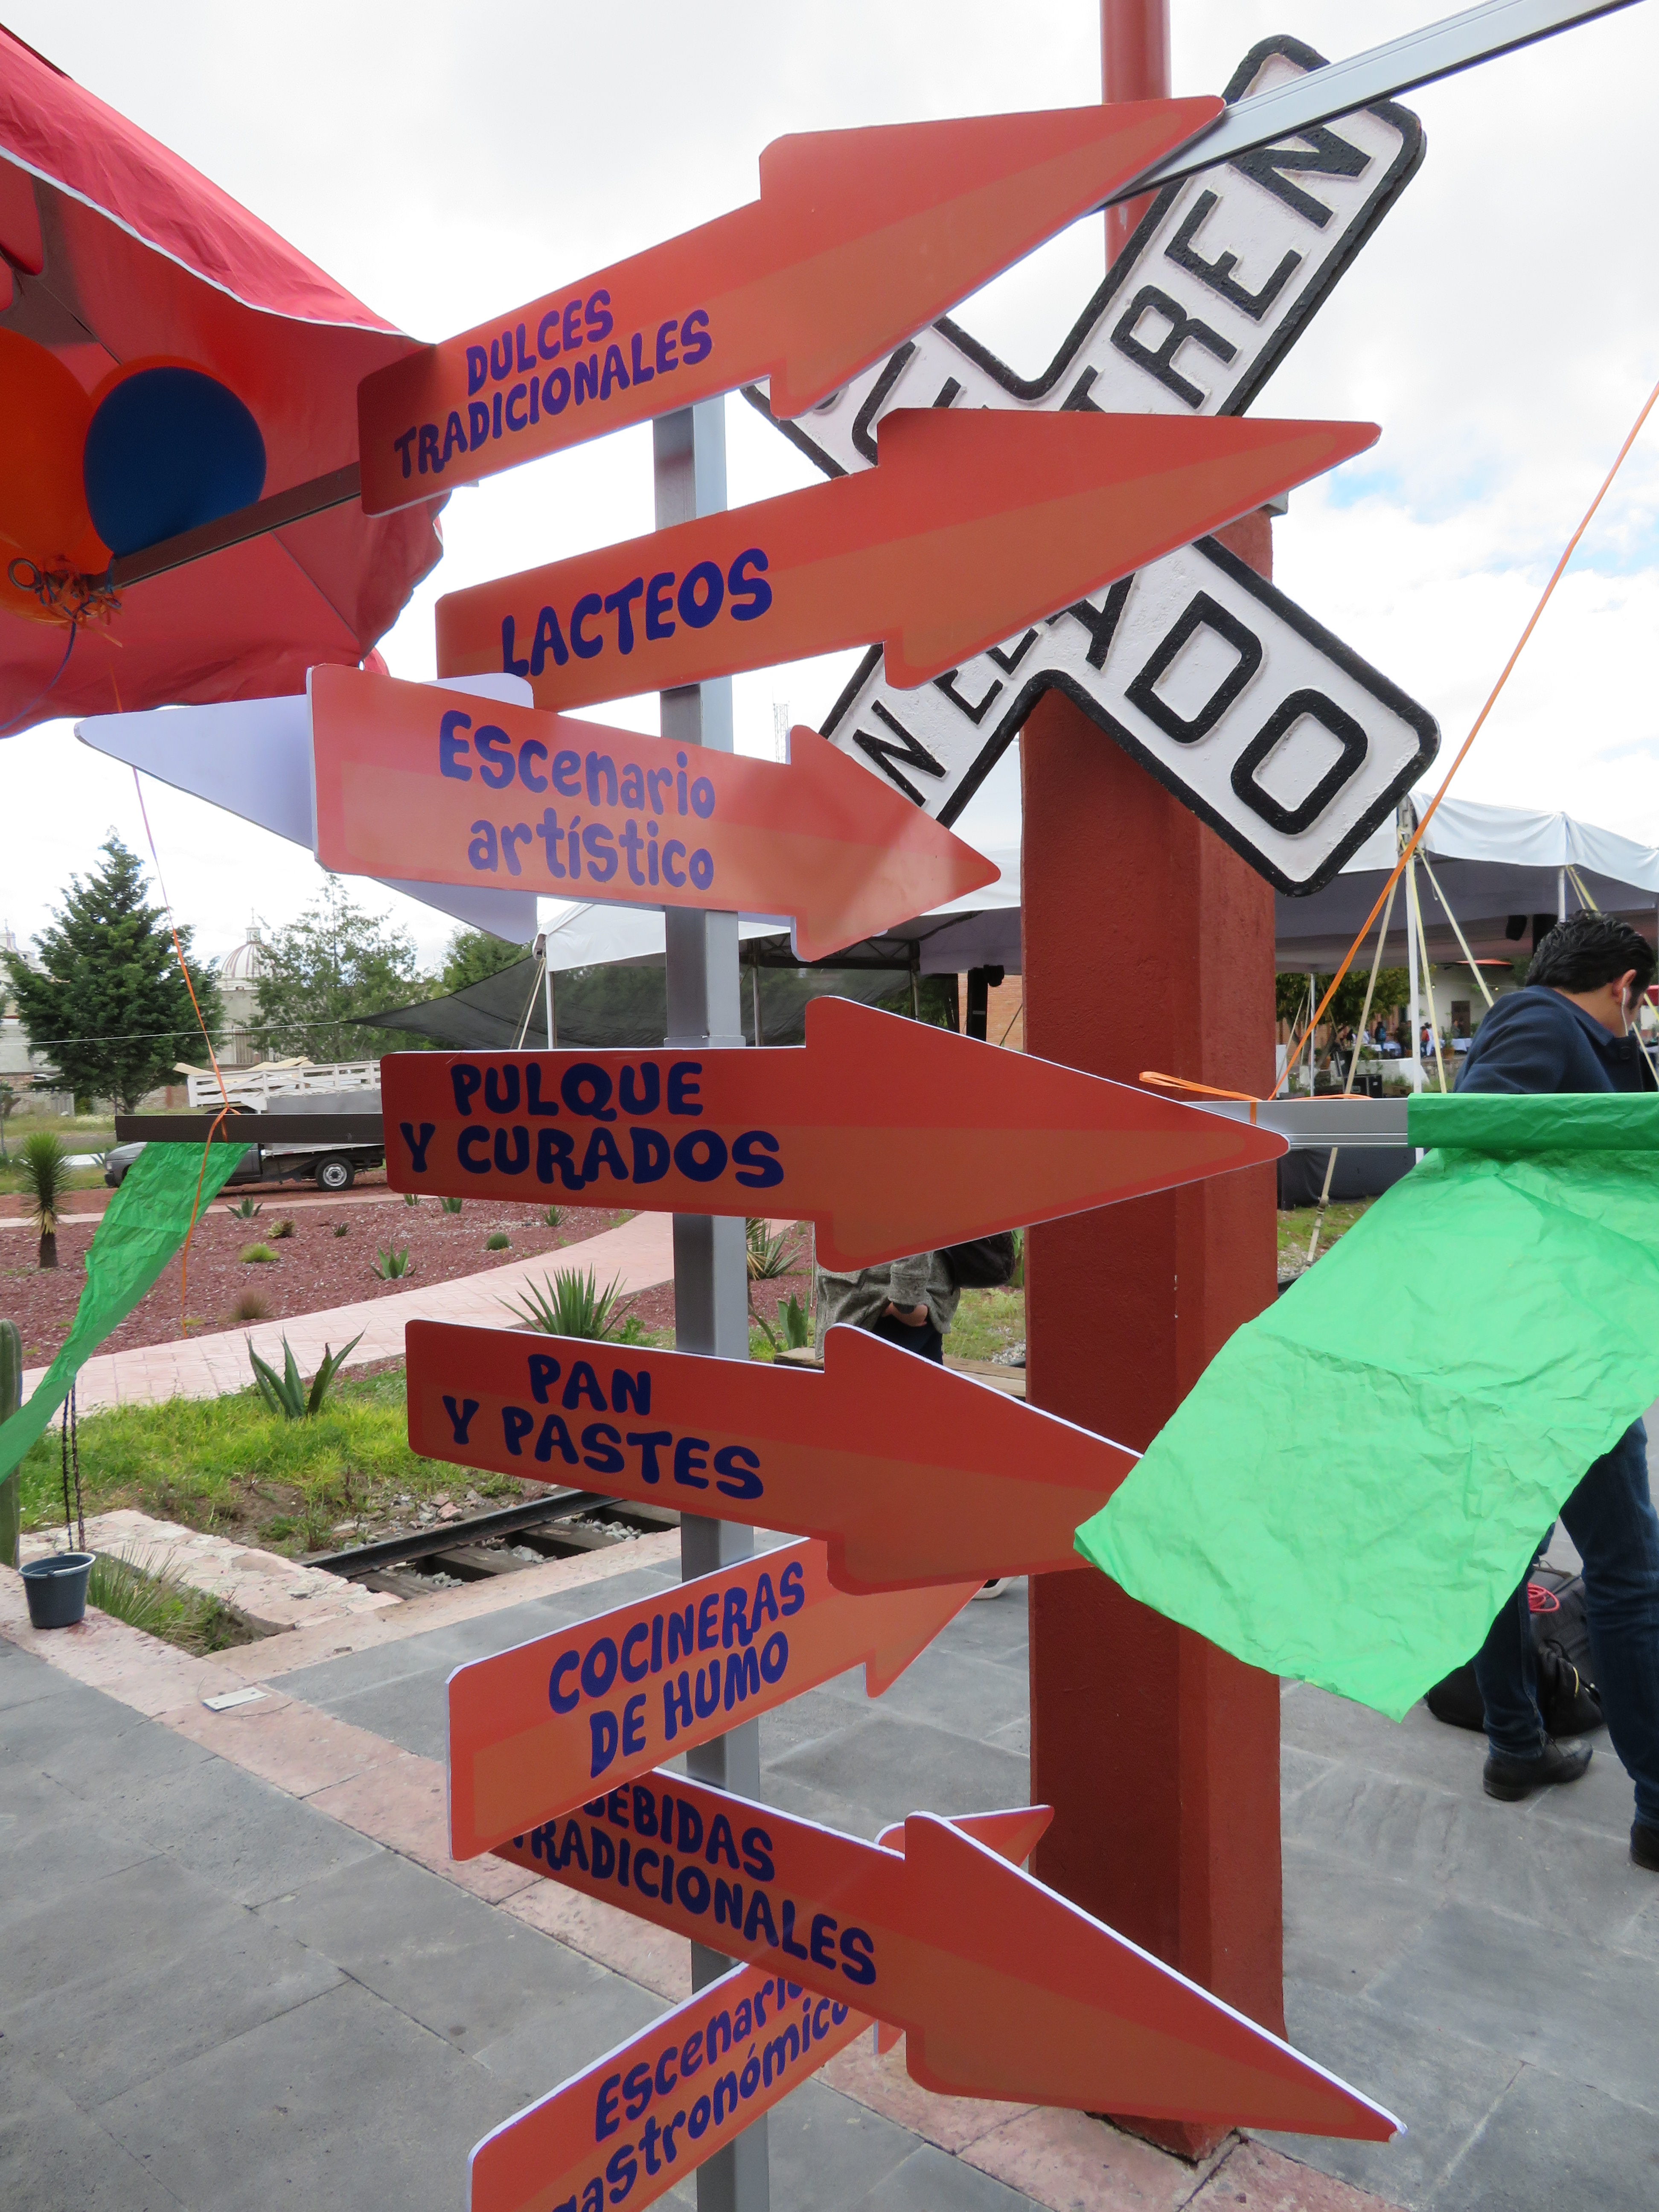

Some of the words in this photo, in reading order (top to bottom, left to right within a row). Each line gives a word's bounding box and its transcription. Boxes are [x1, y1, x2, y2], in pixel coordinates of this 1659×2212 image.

[394, 309, 712, 479] TRADICIONALES
[466, 288, 613, 396] DULCES
[501, 548, 773, 678] LACTEOS
[439, 710, 716, 819] Escenario
[468, 807, 714, 891] artístico
[450, 1062, 704, 1121] PULQUE
[400, 1123, 436, 1173] Y
[457, 1126, 784, 1190] CURADOS
[527, 1354, 651, 1415] PAN
[442, 1395, 480, 1445] Y
[501, 1406, 764, 1499] PASTES
[549, 1562, 805, 1714] COCINERAS
[589, 1694, 646, 1778] DE
[663, 1632, 789, 1740] HUMO
[513, 1819, 876, 1985] RADICIONALES
